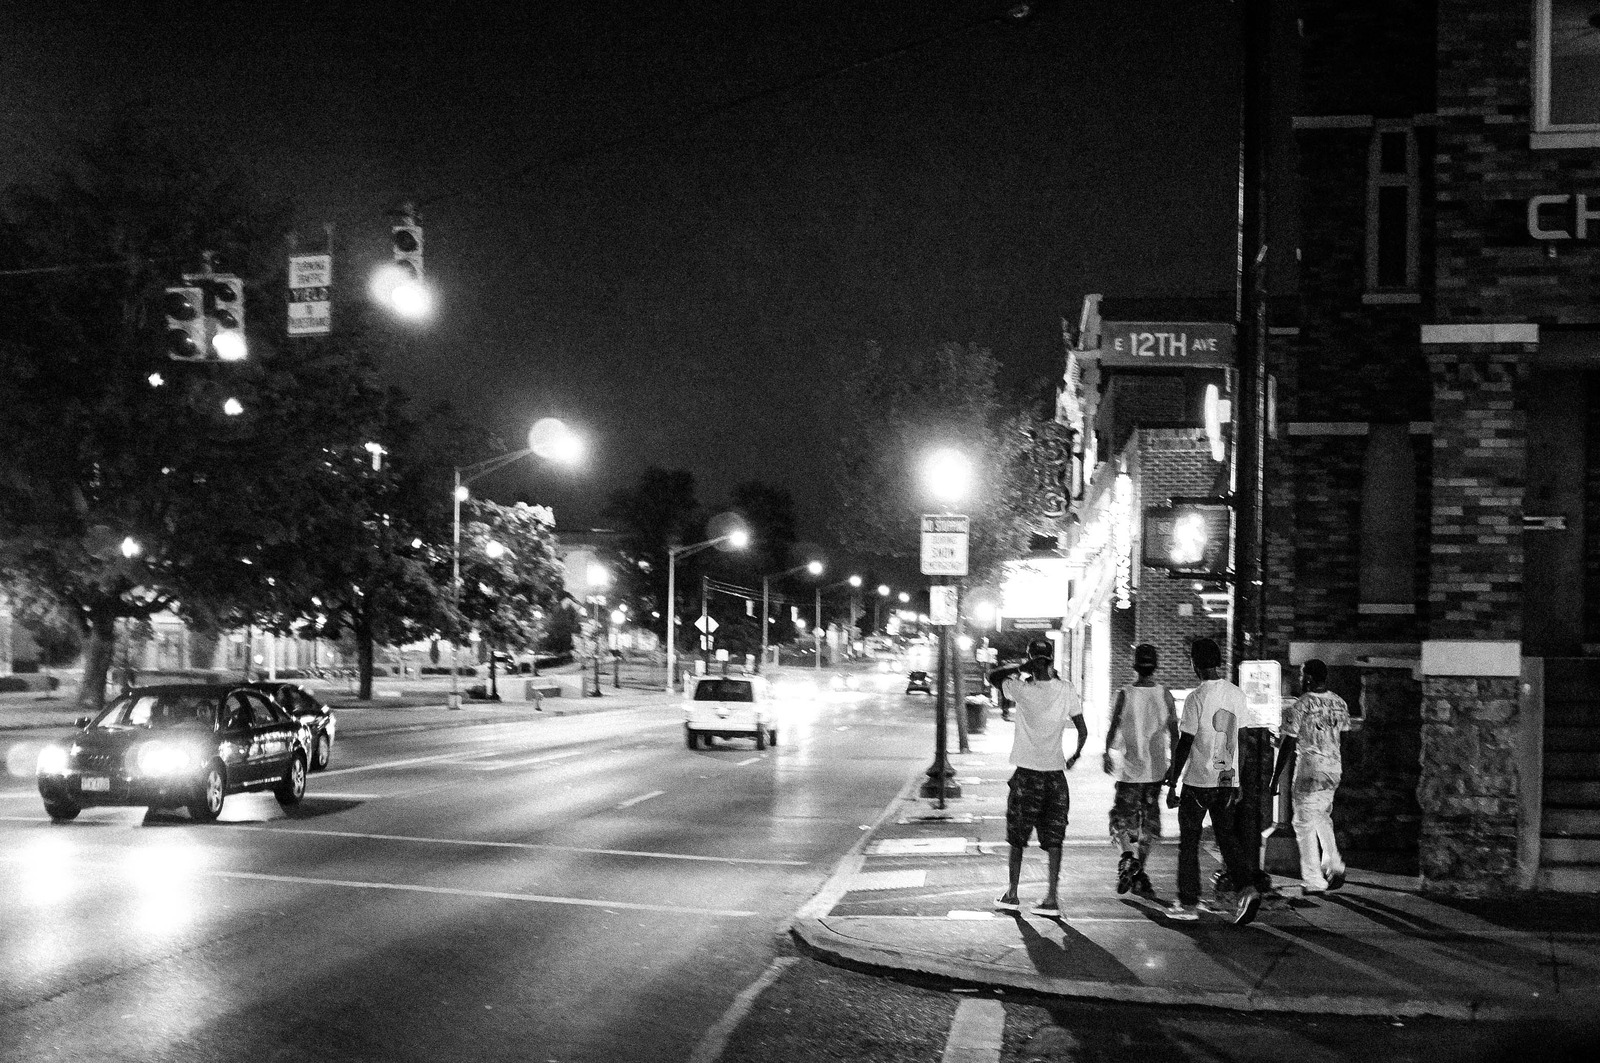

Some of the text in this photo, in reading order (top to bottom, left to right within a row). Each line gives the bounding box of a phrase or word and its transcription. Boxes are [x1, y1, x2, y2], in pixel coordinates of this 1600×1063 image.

[1113, 332, 1218, 356] E 12TH AVE
